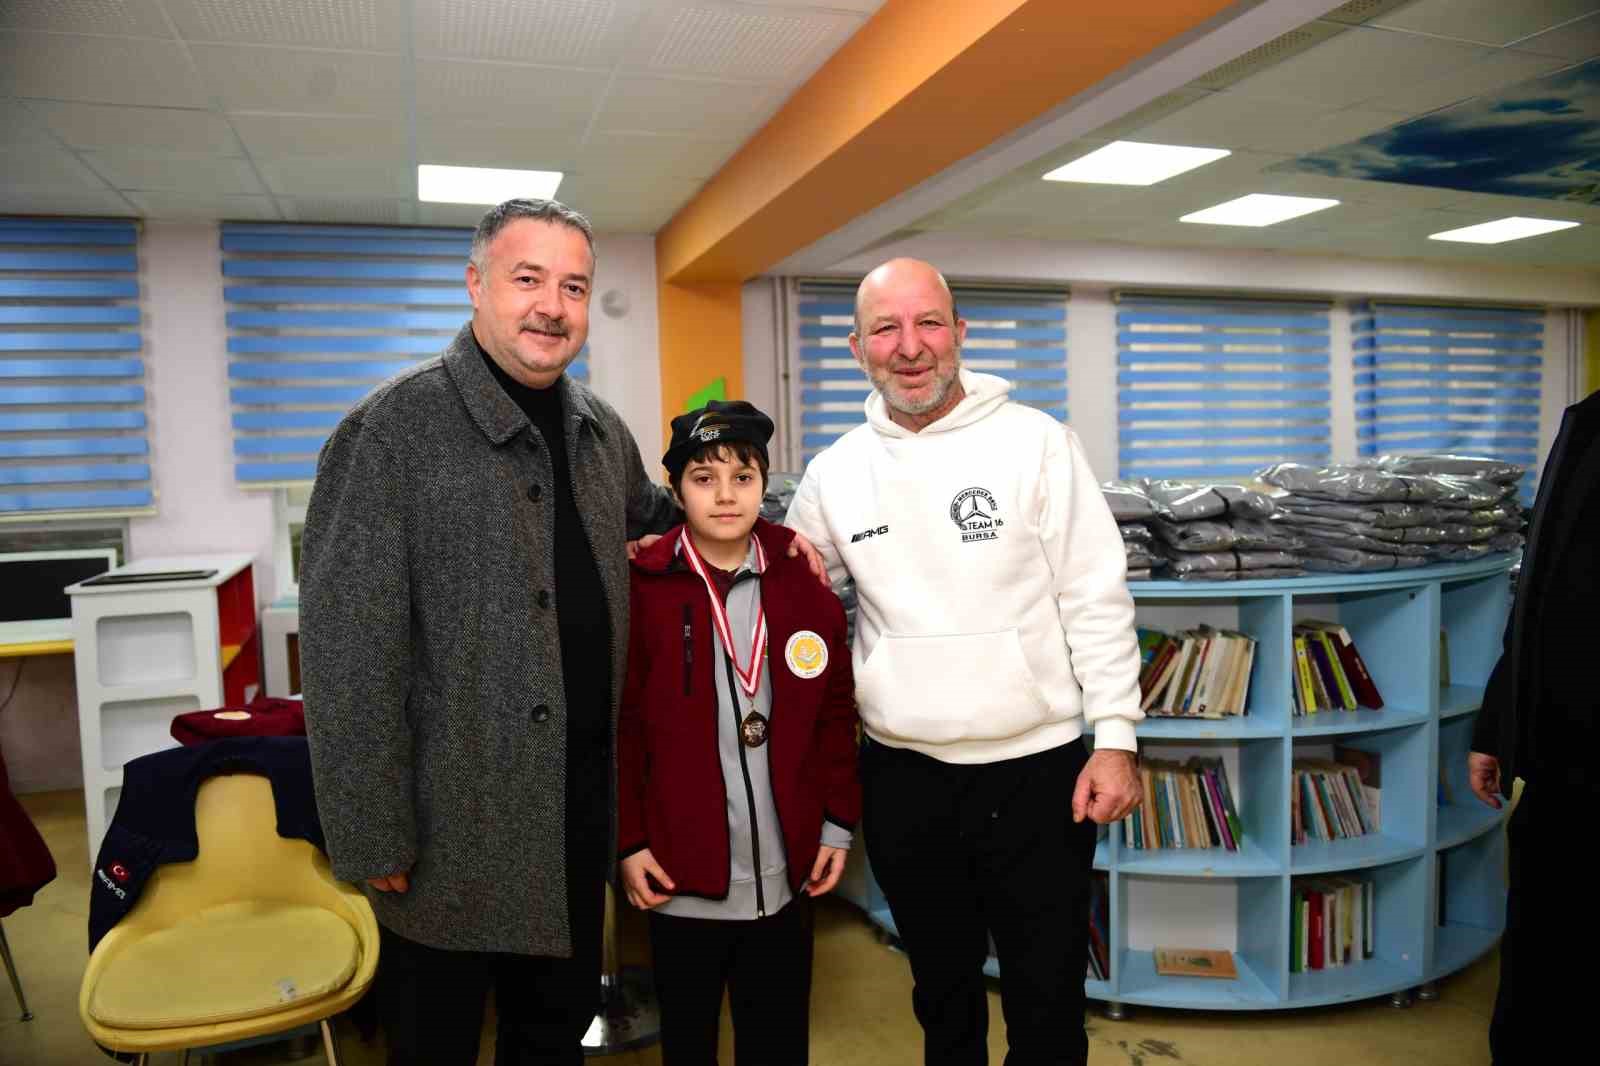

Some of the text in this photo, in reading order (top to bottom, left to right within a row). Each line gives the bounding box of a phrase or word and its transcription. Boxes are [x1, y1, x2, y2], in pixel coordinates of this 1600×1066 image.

[968, 517, 1004, 530] TEAM 16
[962, 531, 997, 542] BURSA
